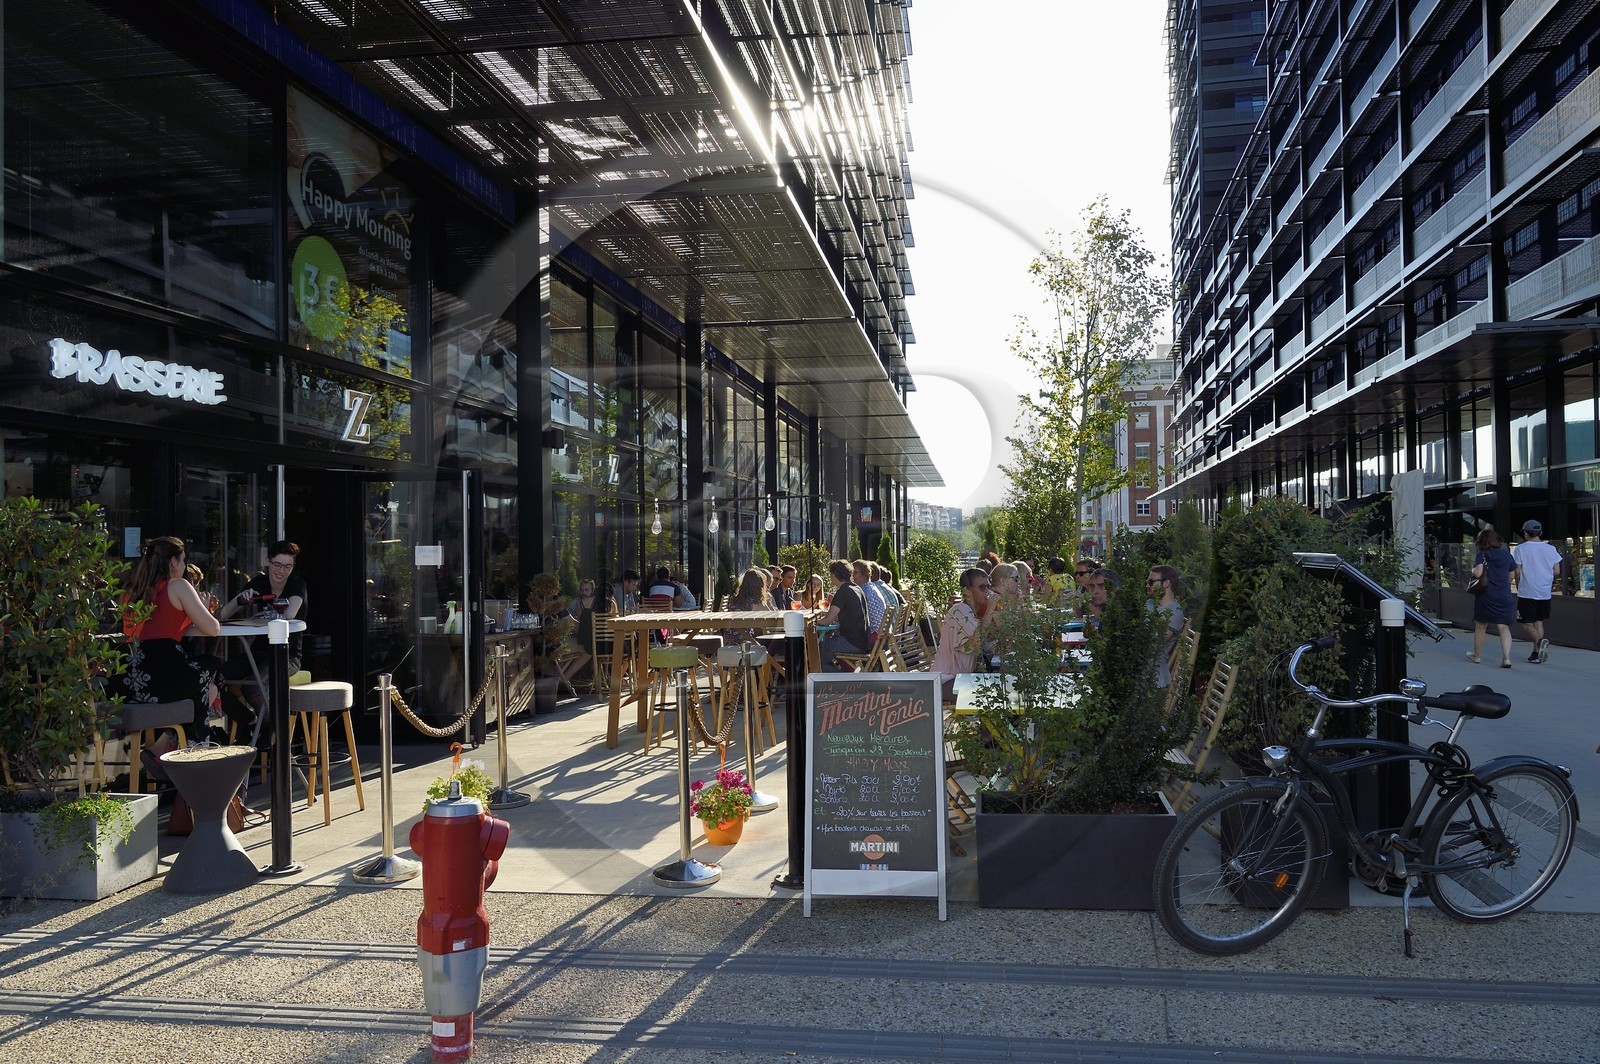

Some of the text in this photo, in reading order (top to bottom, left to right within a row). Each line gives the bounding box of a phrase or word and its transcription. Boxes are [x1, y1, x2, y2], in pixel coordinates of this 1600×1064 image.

[302, 180, 412, 260] Happy Morning
[47, 337, 228, 406] BRASSERIE
[342, 388, 373, 445] Z
[1584, 468, 1600, 491] REST
[819, 686, 892, 736] Martini
[877, 697, 930, 735] Tonic
[850, 842, 898, 853] MARTINI
